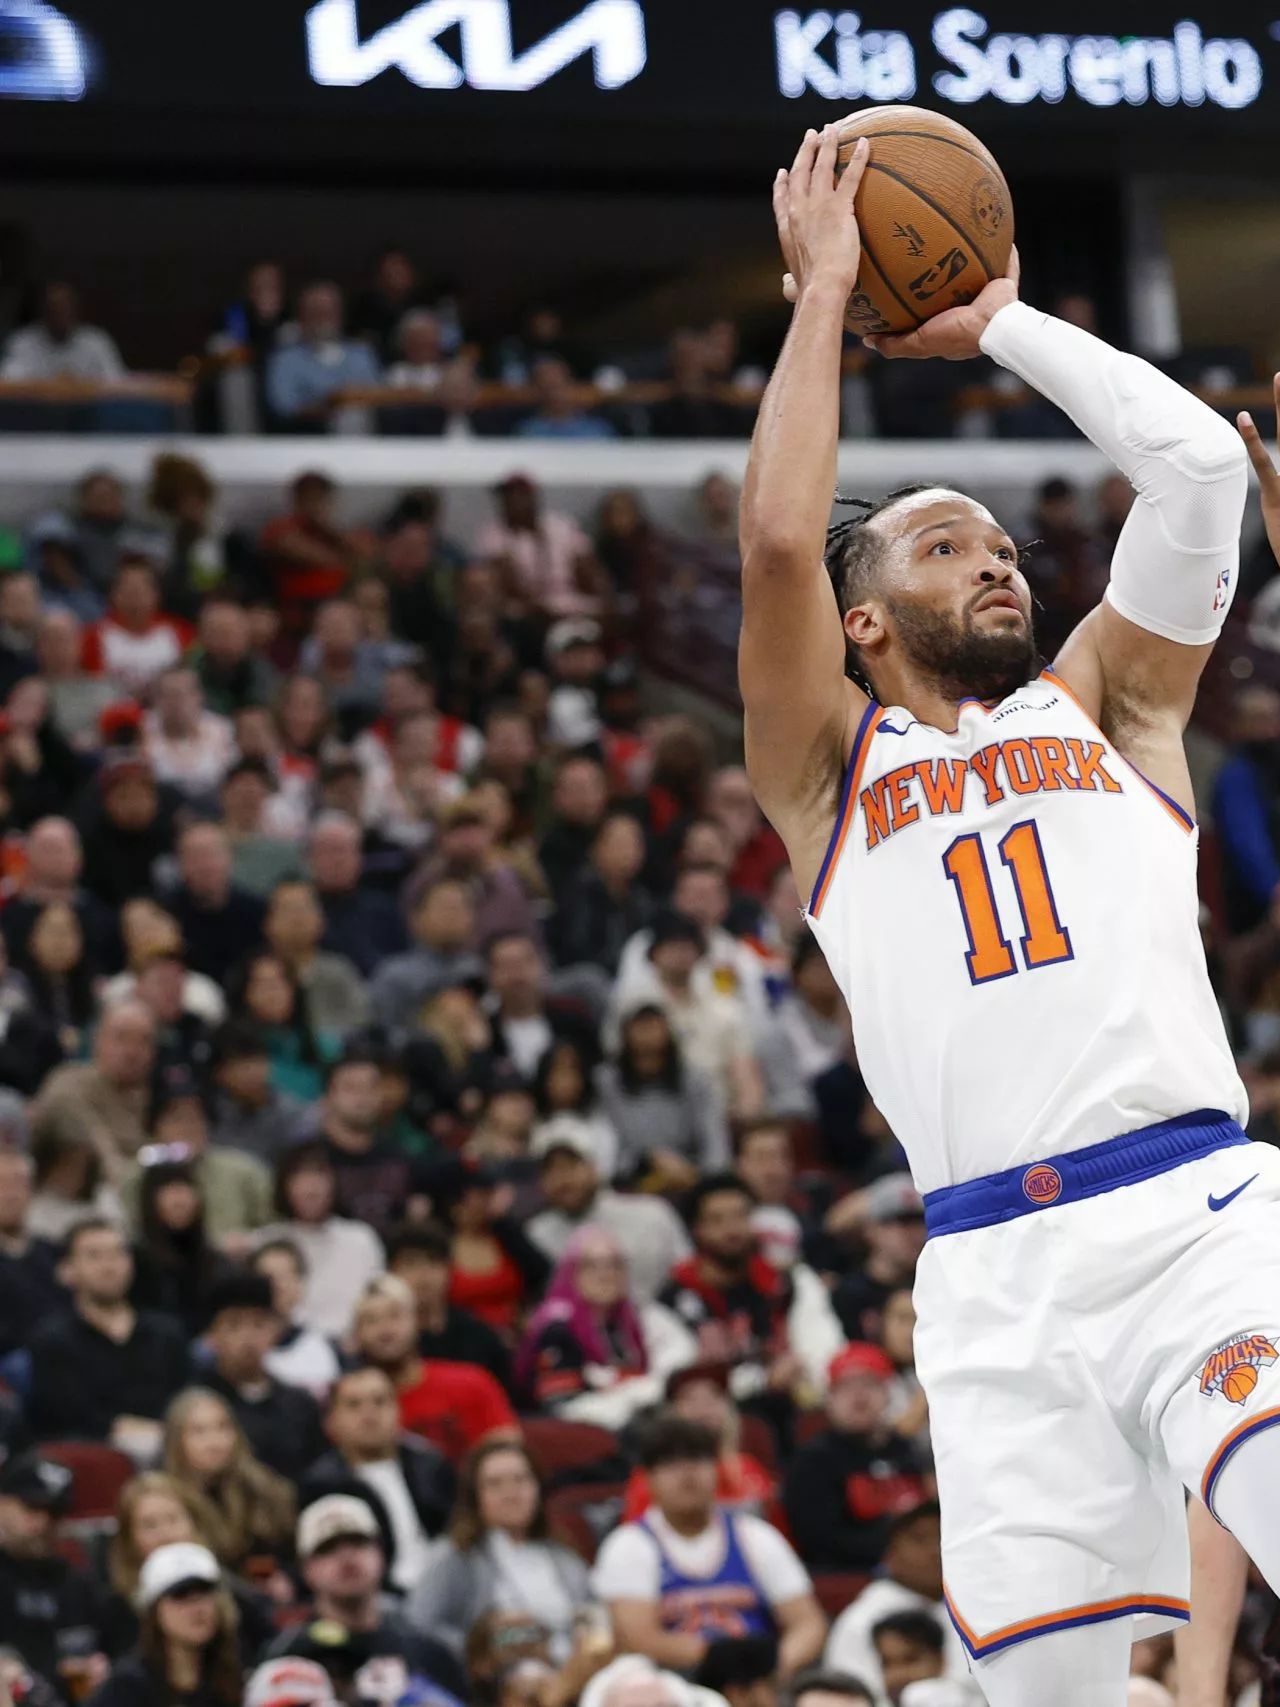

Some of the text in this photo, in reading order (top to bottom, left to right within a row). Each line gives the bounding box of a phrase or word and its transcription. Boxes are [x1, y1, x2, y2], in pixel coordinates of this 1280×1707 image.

[775, 9, 916, 99] Kia
[858, 736, 1124, 853] NEW YORK
[942, 818, 1075, 986] 11
[1027, 1175, 1058, 1194] KNICKS
[1199, 1335, 1280, 1394] KNICKS
